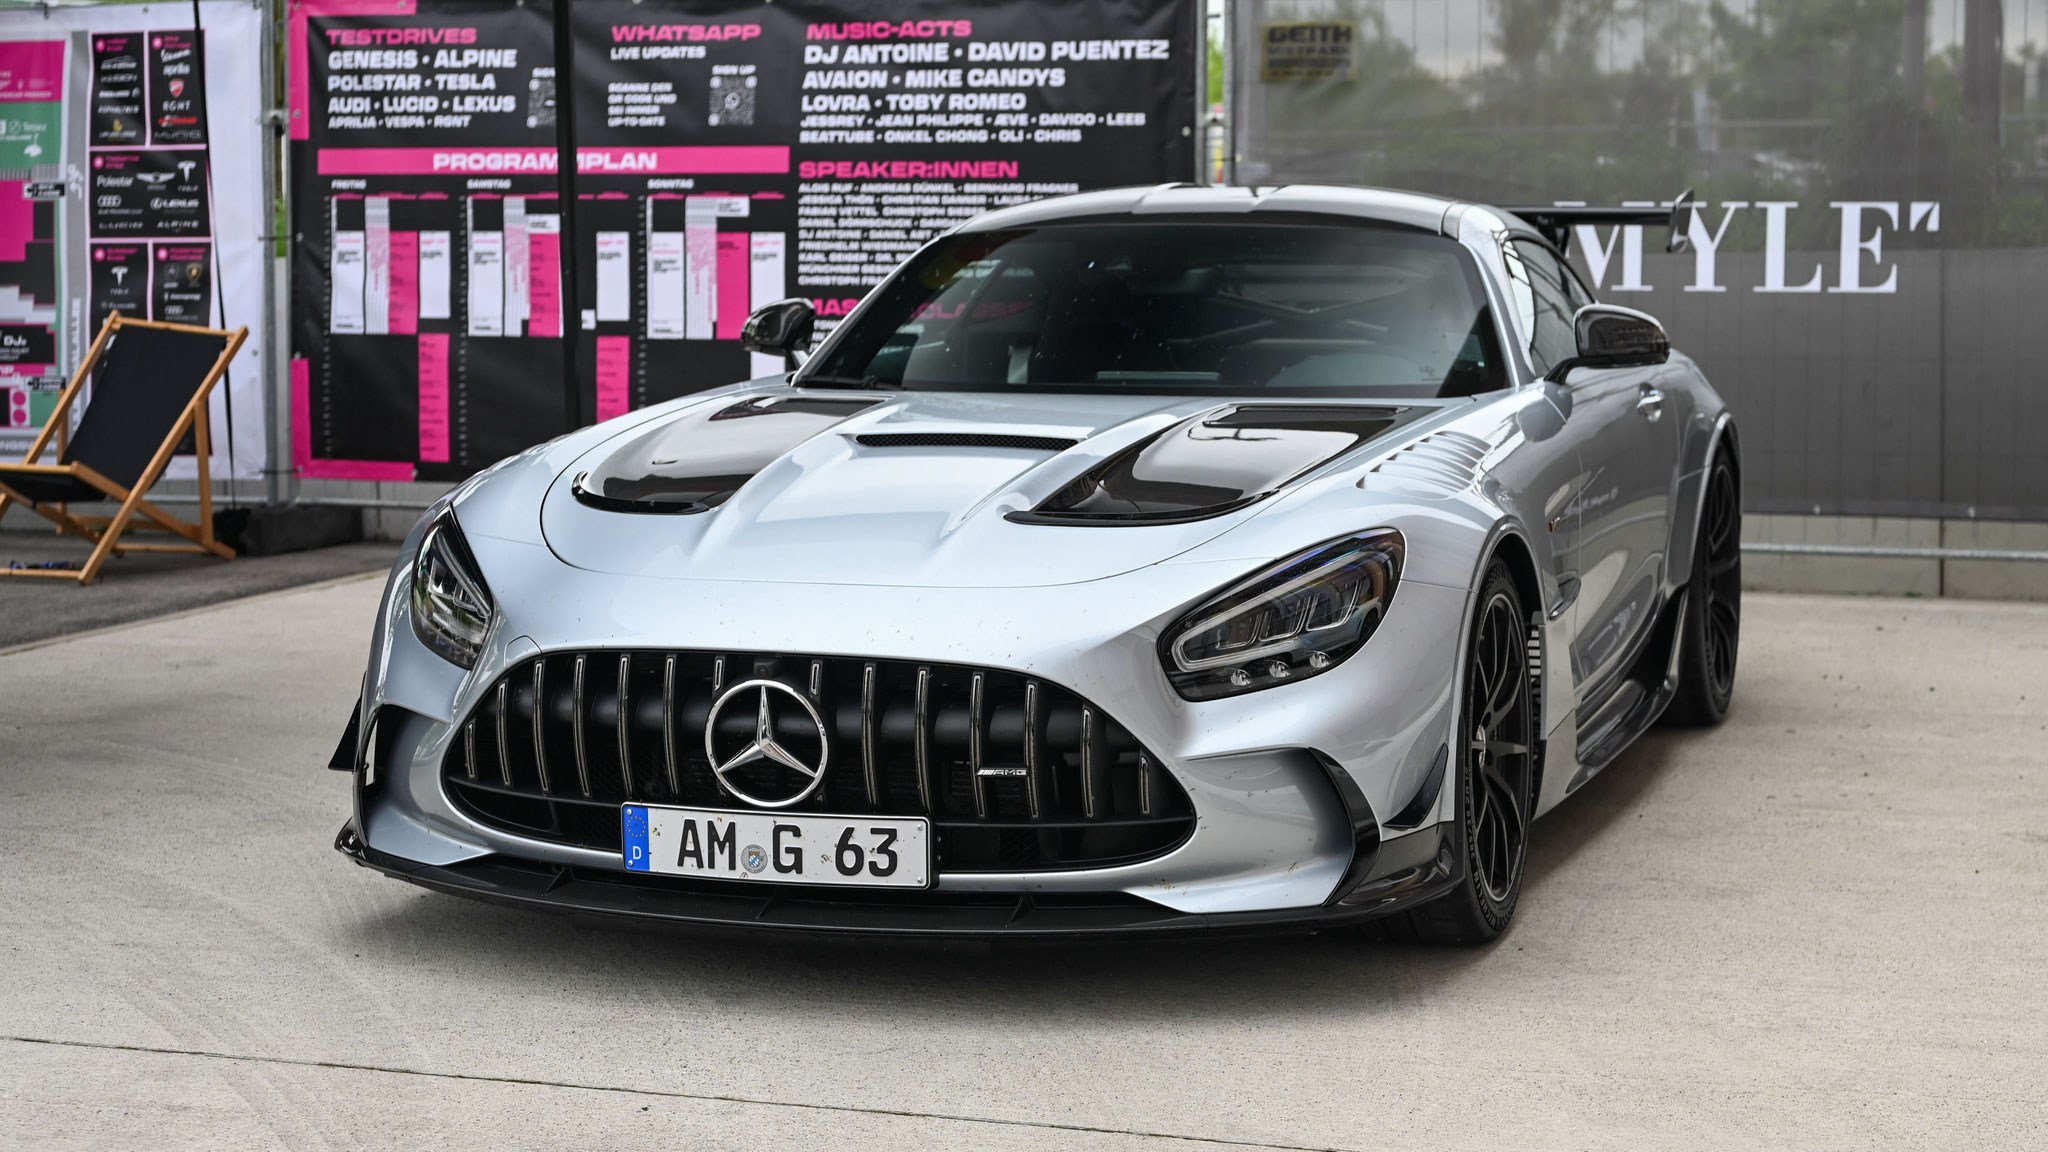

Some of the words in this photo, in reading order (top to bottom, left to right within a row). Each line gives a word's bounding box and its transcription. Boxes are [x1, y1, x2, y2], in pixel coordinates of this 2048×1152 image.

[326, 28, 477, 45] TESTDRIVES
[611, 25, 762, 42] WHATSAPP
[806, 20, 971, 40] MUSIC-ACTS
[1269, 26, 1352, 42] GEITH
[328, 50, 418, 70] GENESIS
[434, 48, 517, 68] ALPINE
[611, 46, 639, 60] LIVE
[642, 46, 706, 60] UPDATES
[804, 44, 839, 64] DJ
[842, 43, 949, 63] ANTOINE
[967, 41, 1047, 61] DAVID
[1051, 40, 1169, 60] PUENTEZ
[712, 64, 738, 75] SIGN
[739, 64, 757, 75] UP
[327, 74, 421, 92] POLESTAR
[435, 74, 496, 91] TESLA
[802, 70, 888, 89] AVAION
[904, 69, 963, 88] MIKE
[967, 68, 1066, 87] CANDYS
[327, 97, 371, 114] AUDI
[383, 97, 439, 114] LUCID
[452, 96, 516, 113] LEXUS
[801, 94, 871, 112] LOVRA
[886, 94, 946, 112] TOBY
[948, 93, 1027, 111] ROMEO
[328, 116, 377, 129] APRILIA
[385, 116, 425, 129] VESPA
[434, 115, 471, 128] RGNT
[875, 114, 915, 127] JEAN
[916, 114, 984, 127] PHILIPPE
[1038, 113, 1095, 126] DAVIDO
[1106, 113, 1145, 126] LEEB
[884, 130, 933, 143] ONKEL
[934, 130, 988, 143] CHONG
[998, 130, 1024, 142] OLI
[1033, 129, 1082, 142] CHRIS
[799, 161, 1018, 179] SPEAKER:INNEN
[97, 175, 134, 187] Polestar
[632, 845, 642, 861] D
[677, 819, 737, 871] AM
[773, 824, 803, 875] G
[835, 827, 899, 877] 63
[1474, 870, 1496, 928] MICHELIN
